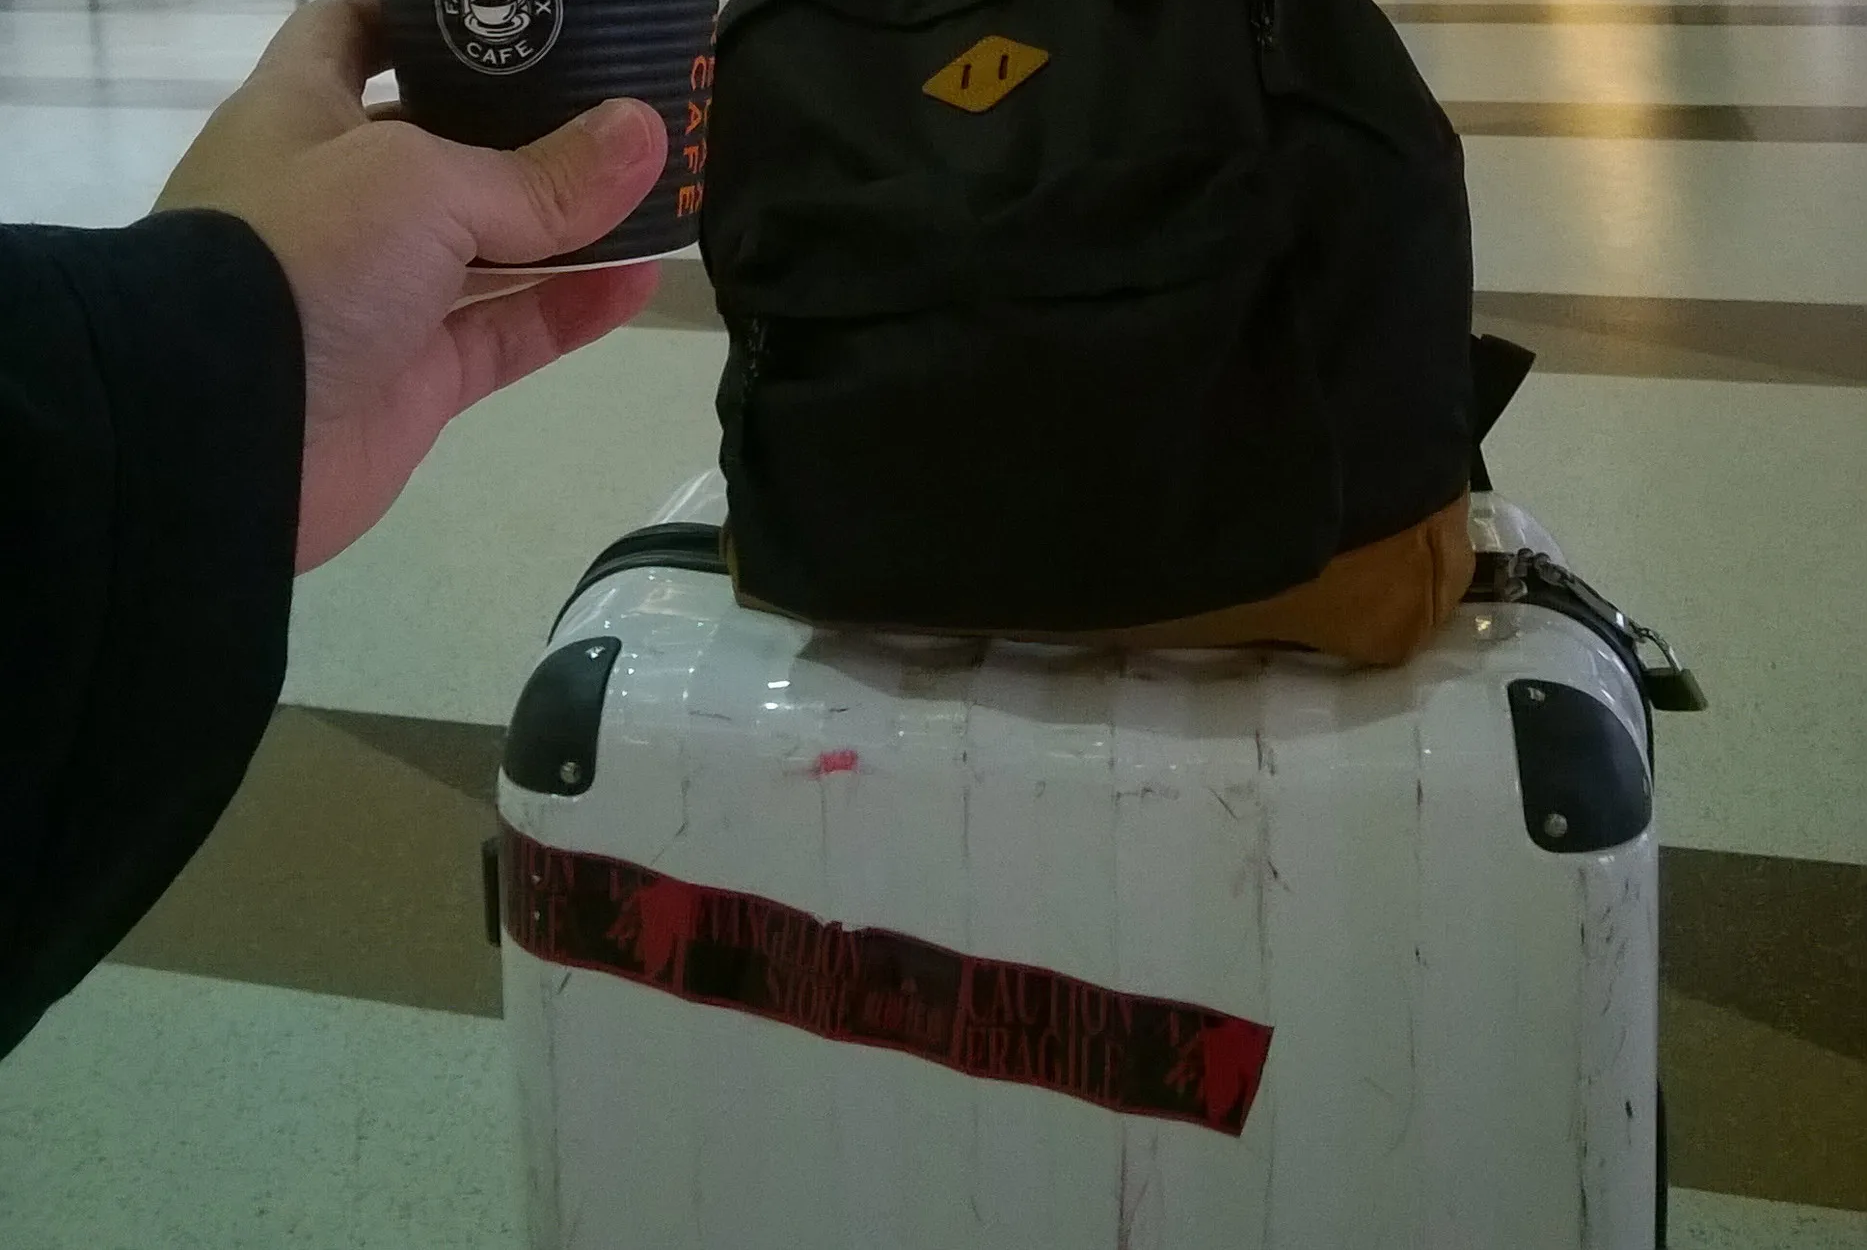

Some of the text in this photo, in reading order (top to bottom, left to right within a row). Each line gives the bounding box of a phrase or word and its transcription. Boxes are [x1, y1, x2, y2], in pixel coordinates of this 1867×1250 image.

[466, 40, 533, 64] CAFE
[677, 55, 707, 217] CAFE
[968, 961, 1133, 1035] CAUTION
[966, 1026, 1125, 1103] FRAGILE
